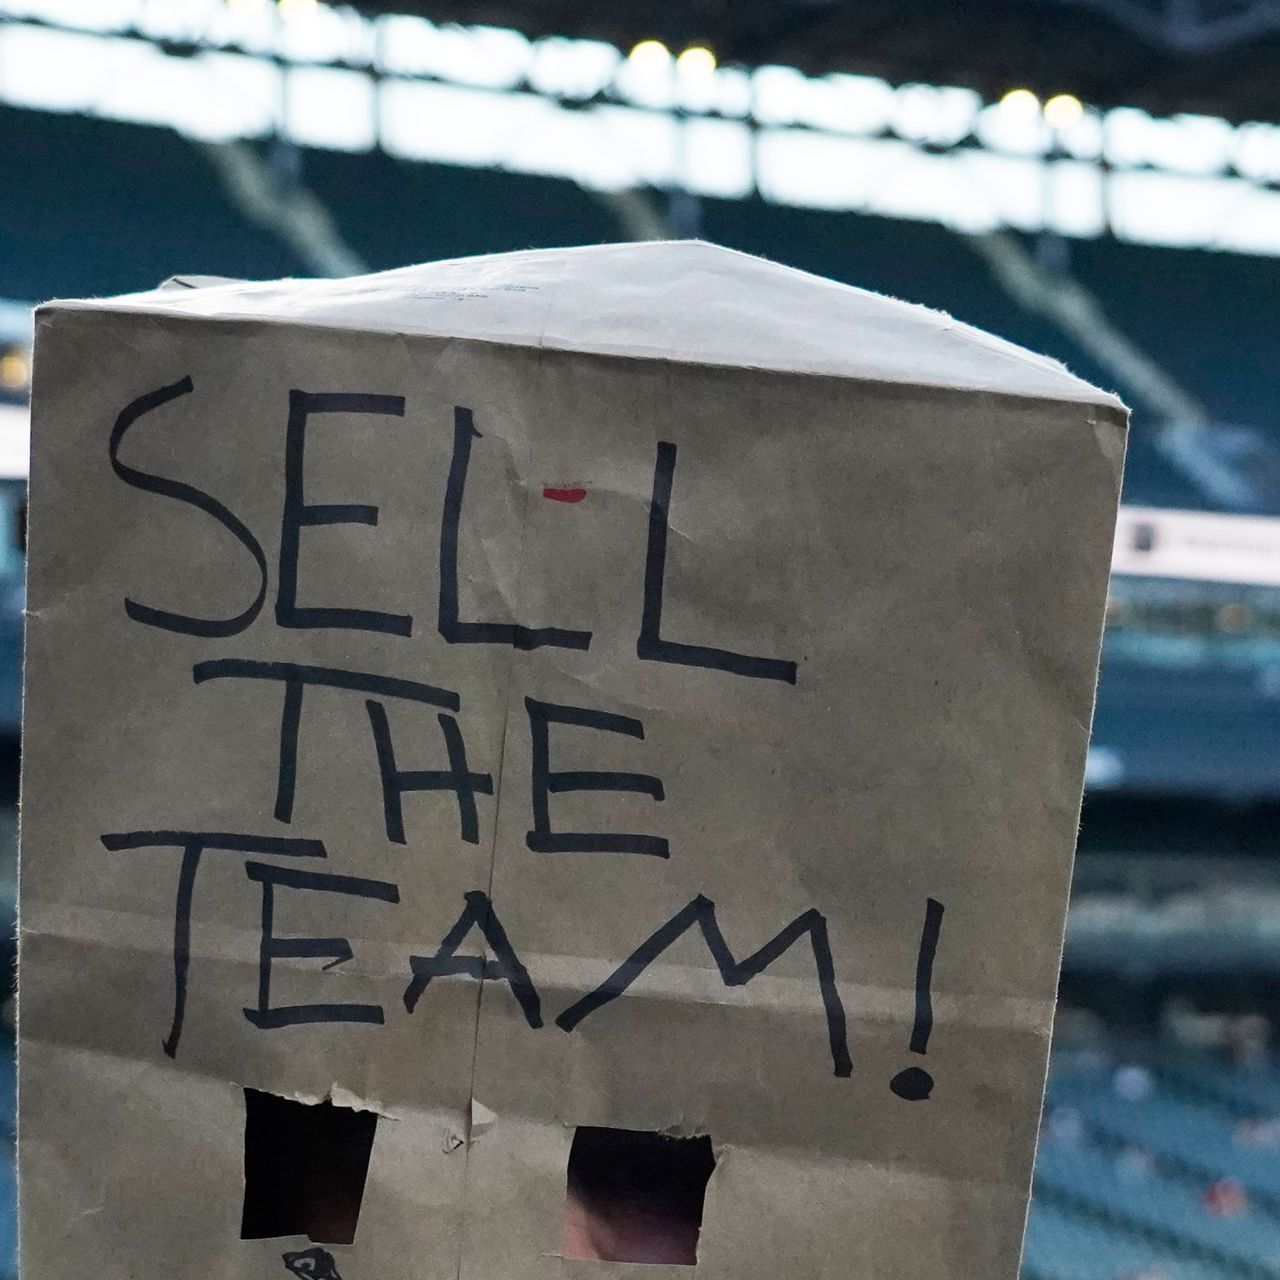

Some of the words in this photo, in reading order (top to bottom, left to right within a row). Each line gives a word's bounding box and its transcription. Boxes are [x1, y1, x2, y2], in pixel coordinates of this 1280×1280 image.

[109, 375, 798, 685] SELL
[193, 658, 671, 859] THE
[100, 831, 945, 1102] TEAM!
